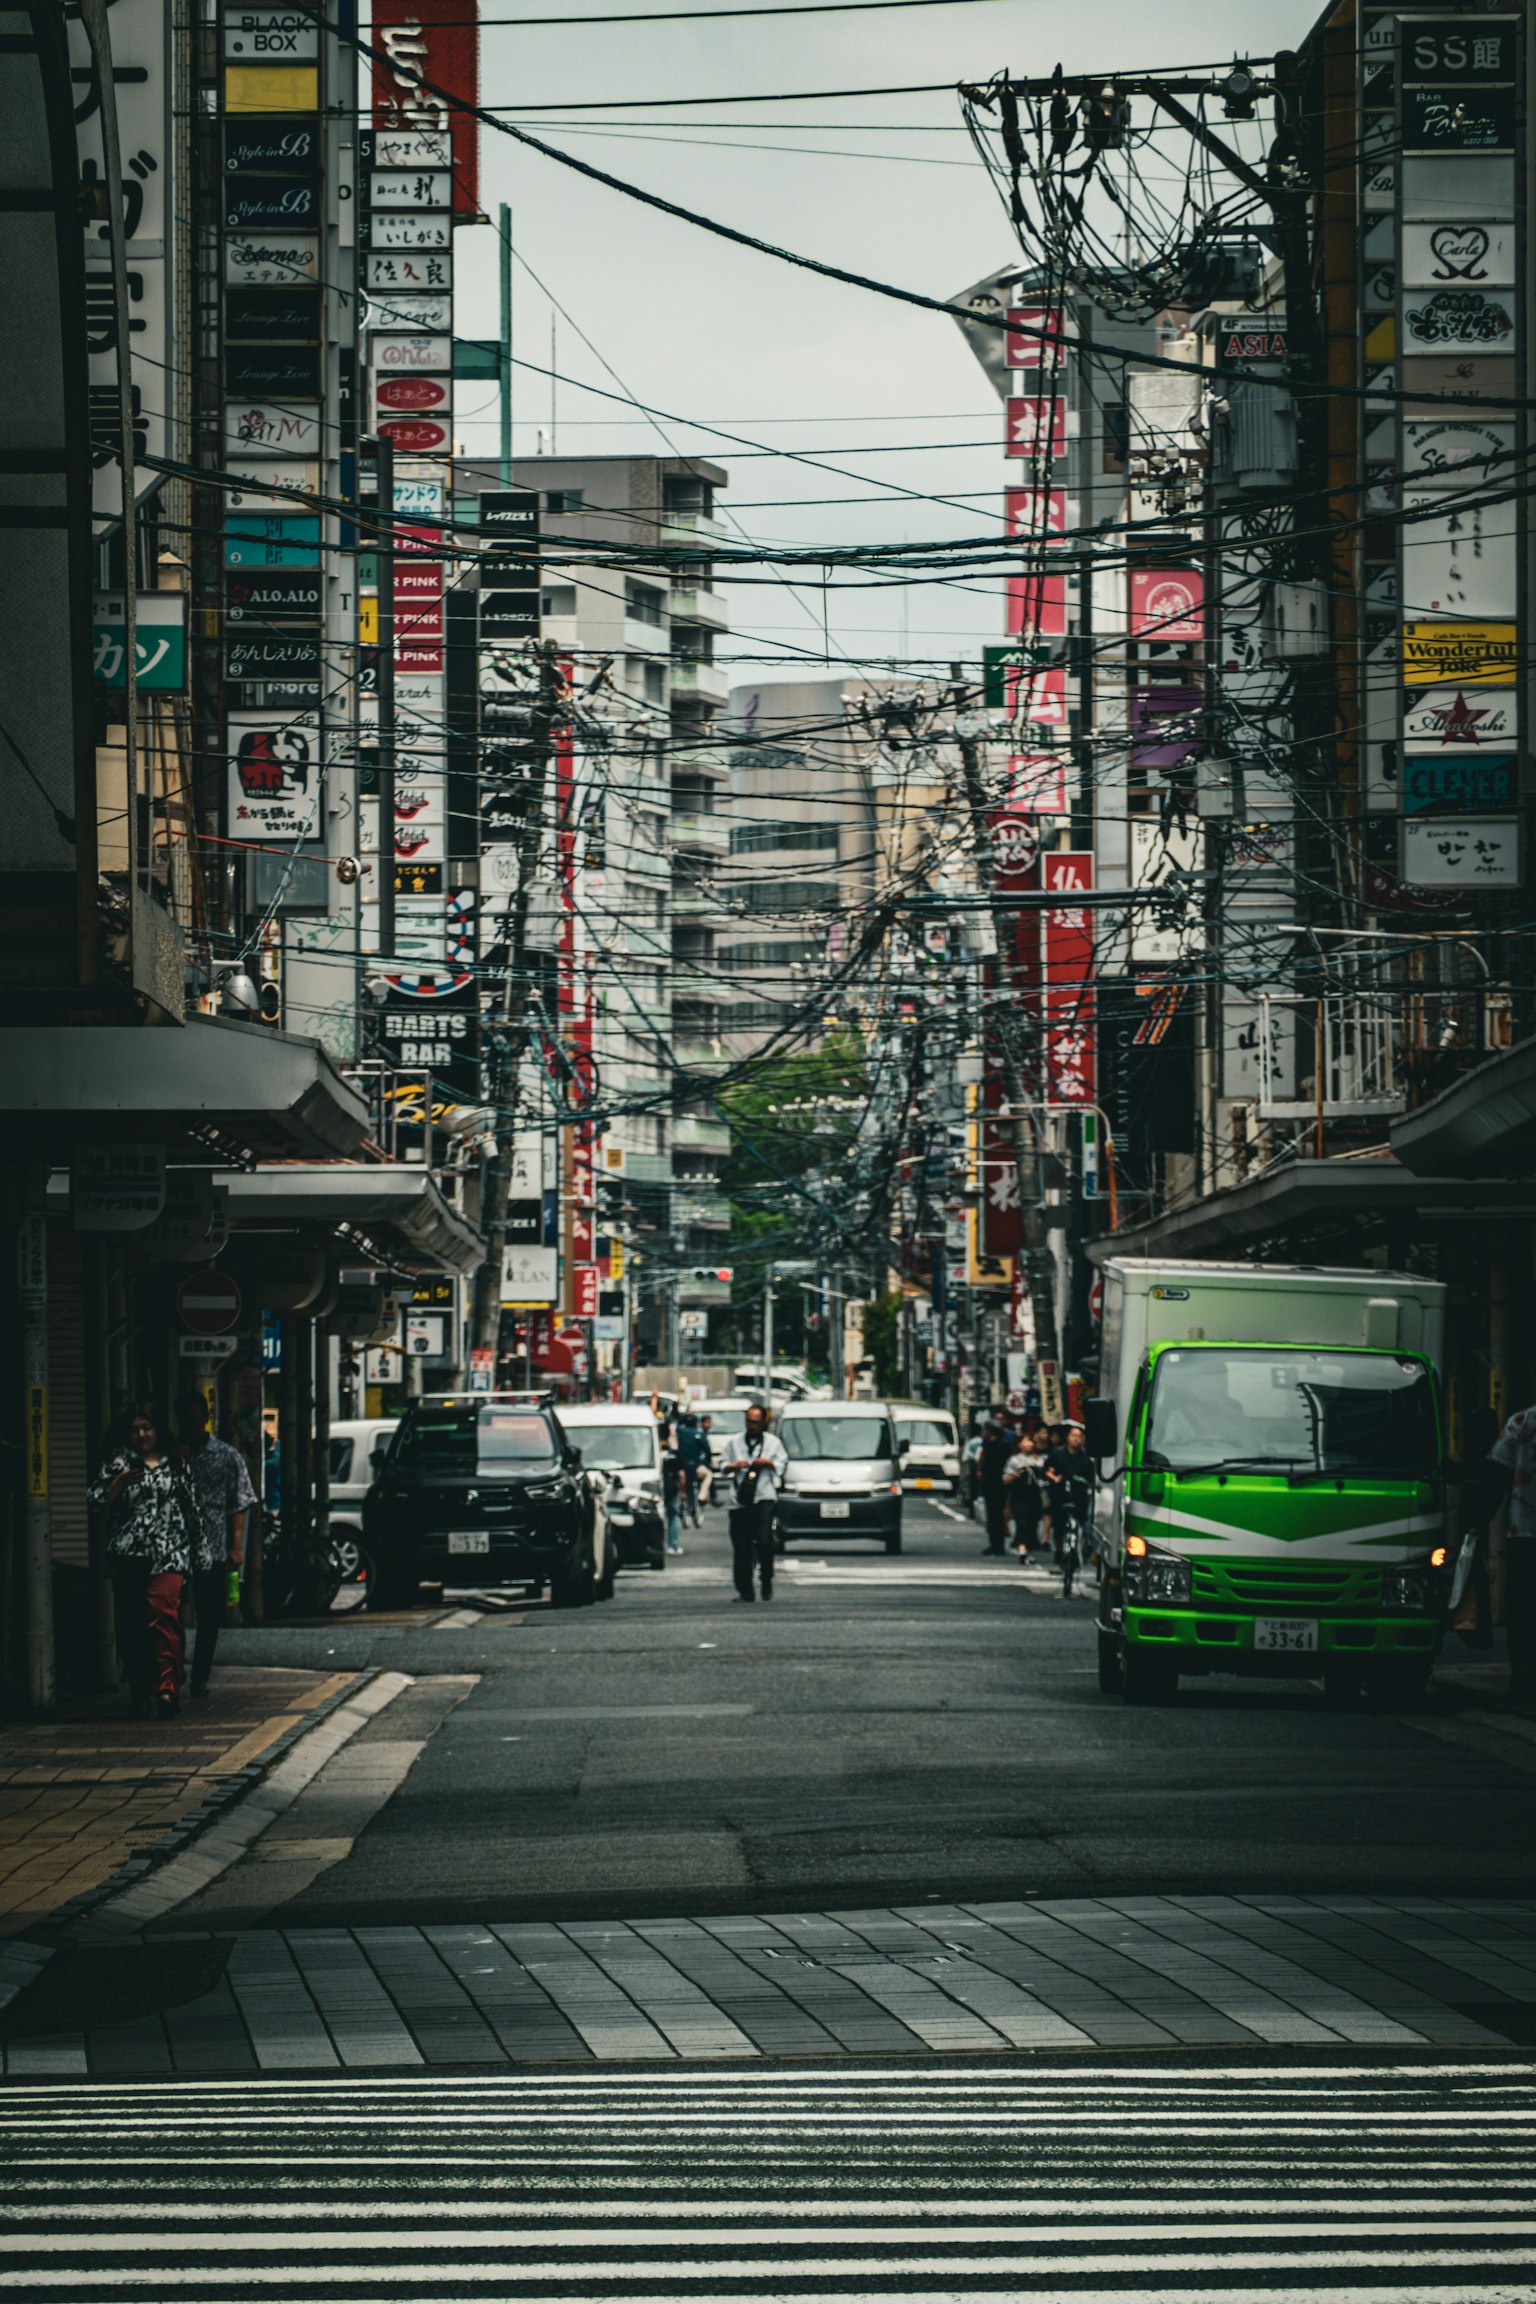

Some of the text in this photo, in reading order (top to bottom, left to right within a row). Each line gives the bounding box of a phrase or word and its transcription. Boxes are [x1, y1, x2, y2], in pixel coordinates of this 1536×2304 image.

[241, 16, 310, 33] BLACK
[254, 35, 297, 51] BOX
[1414, 36, 1502, 70] SS館
[278, 132, 311, 158] B
[361, 141, 371, 156] 5
[279, 188, 312, 214] B
[386, 229, 446, 245] いしがき
[374, 258, 446, 285] 佐久良
[1224, 320, 1239, 329] 4F
[1224, 335, 1289, 357] ASIA
[1412, 424, 1506, 449] PARADISE FACTORY TEAM
[402, 577, 439, 587] PINK
[250, 590, 318, 603] ALO.ALO
[402, 614, 439, 624] PINK
[402, 651, 439, 661] PINK
[1408, 694, 1416, 704] 3
[385, 1015, 467, 1038] DARTS
[401, 1043, 452, 1066] BAR
[1268, 1631, 1312, 1649] 33-61
